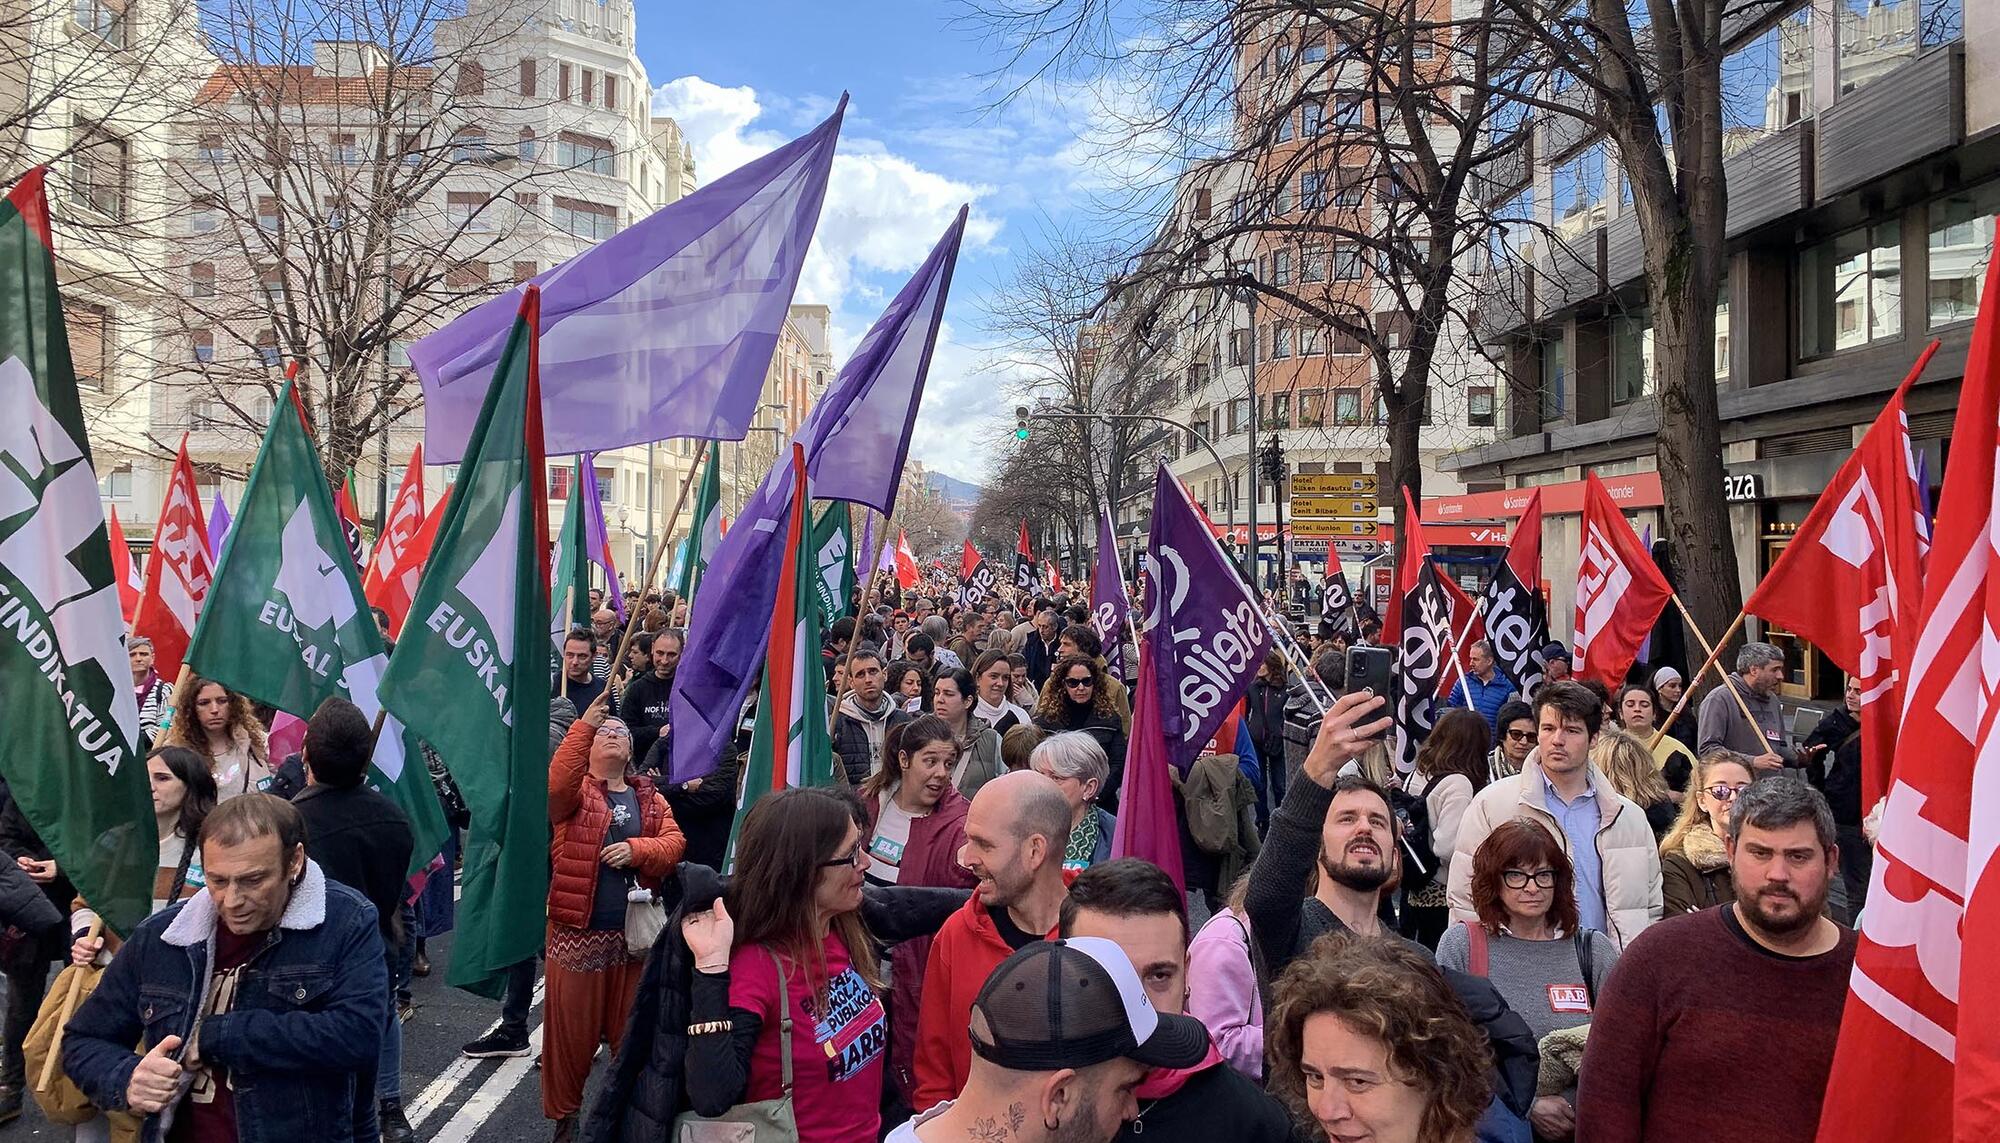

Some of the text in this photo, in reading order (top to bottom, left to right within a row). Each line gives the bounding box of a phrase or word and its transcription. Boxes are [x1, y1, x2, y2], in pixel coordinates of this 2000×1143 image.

[1723, 474, 1756, 500] aza
[0, 583, 123, 776] INDIKATUA
[1552, 989, 1586, 1002] LAB
